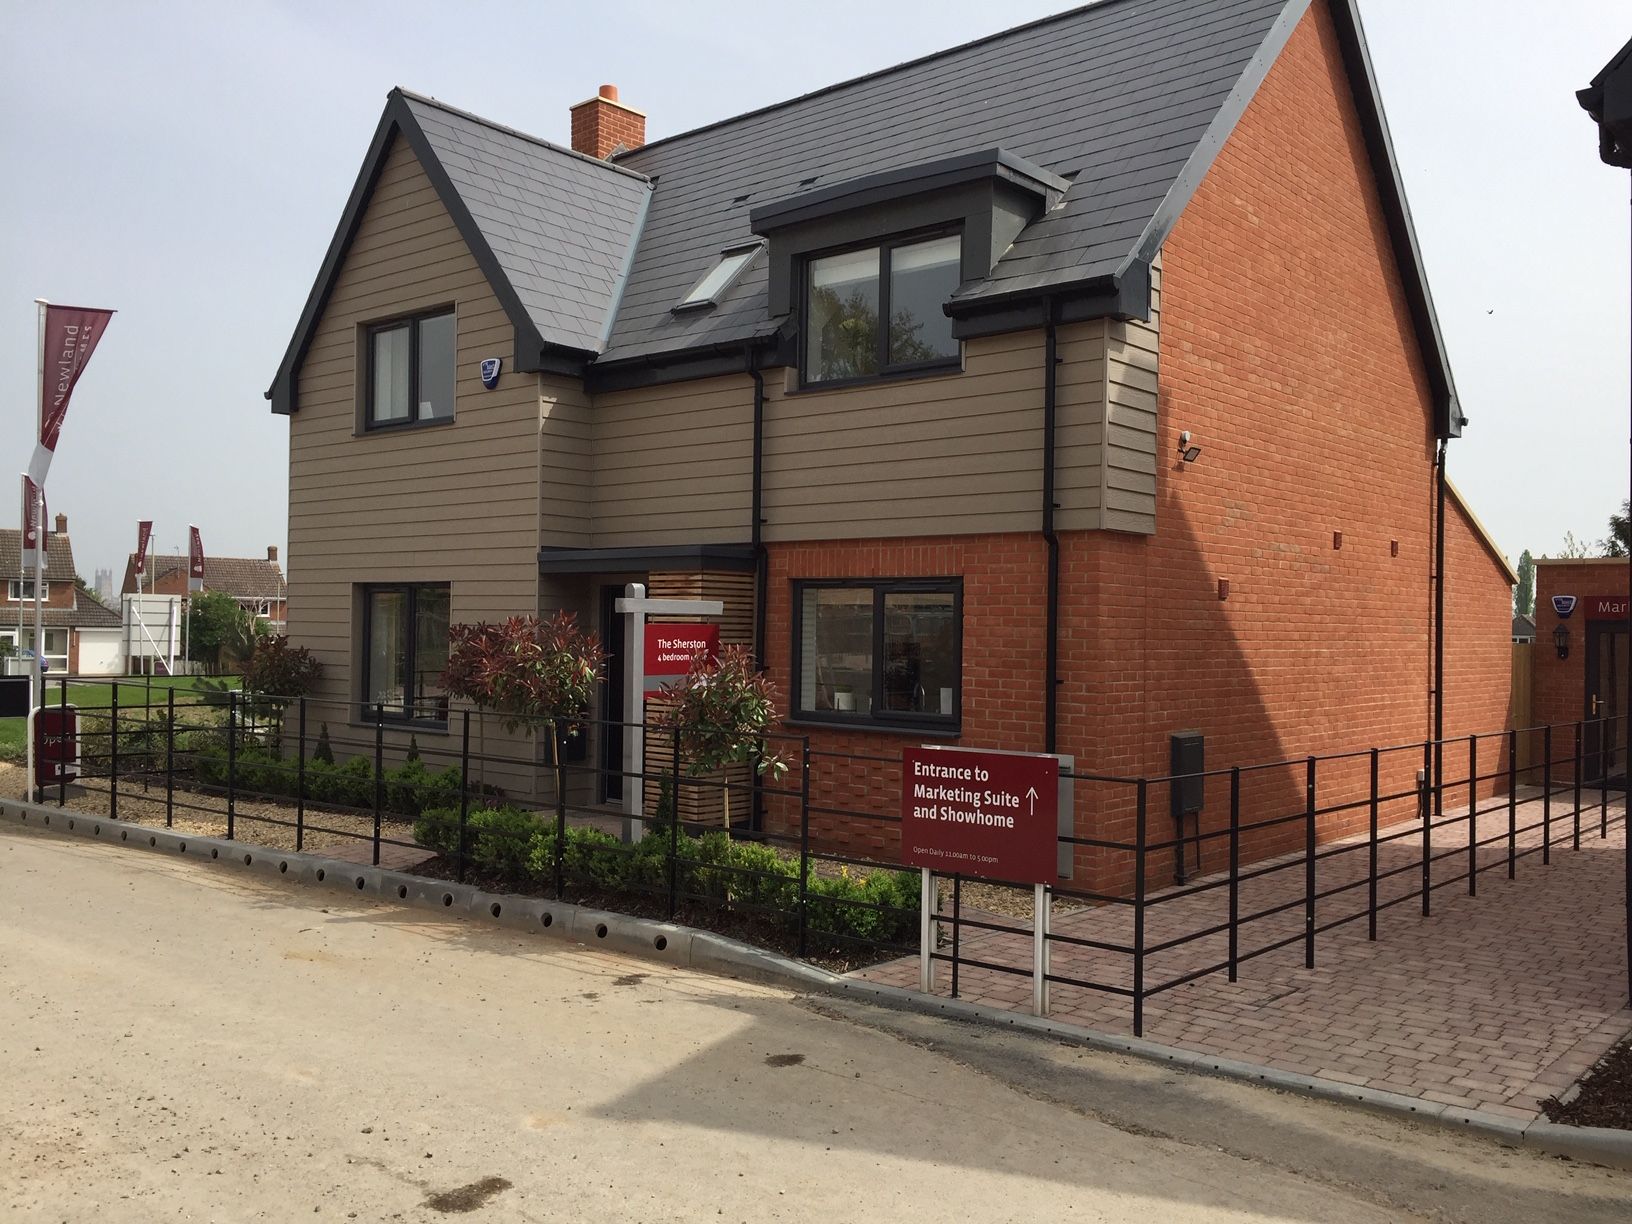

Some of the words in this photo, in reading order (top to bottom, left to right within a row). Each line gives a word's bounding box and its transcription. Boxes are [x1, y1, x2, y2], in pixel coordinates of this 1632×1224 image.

[54, 324, 79, 406] Newland
[1598, 601, 1630, 613] Mar
[657, 639, 672, 649] The
[673, 639, 706, 649] Sherston
[663, 653, 689, 661] bedroom
[914, 761, 971, 780] Entrance
[974, 766, 989, 781] to
[914, 784, 980, 807] Marketing
[984, 790, 1020, 808] Suite
[913, 804, 937, 820] and
[940, 806, 1014, 828] Showhome
[913, 846, 929, 855] Open
[929, 847, 944, 857] Daily
[969, 853, 976, 861] to
